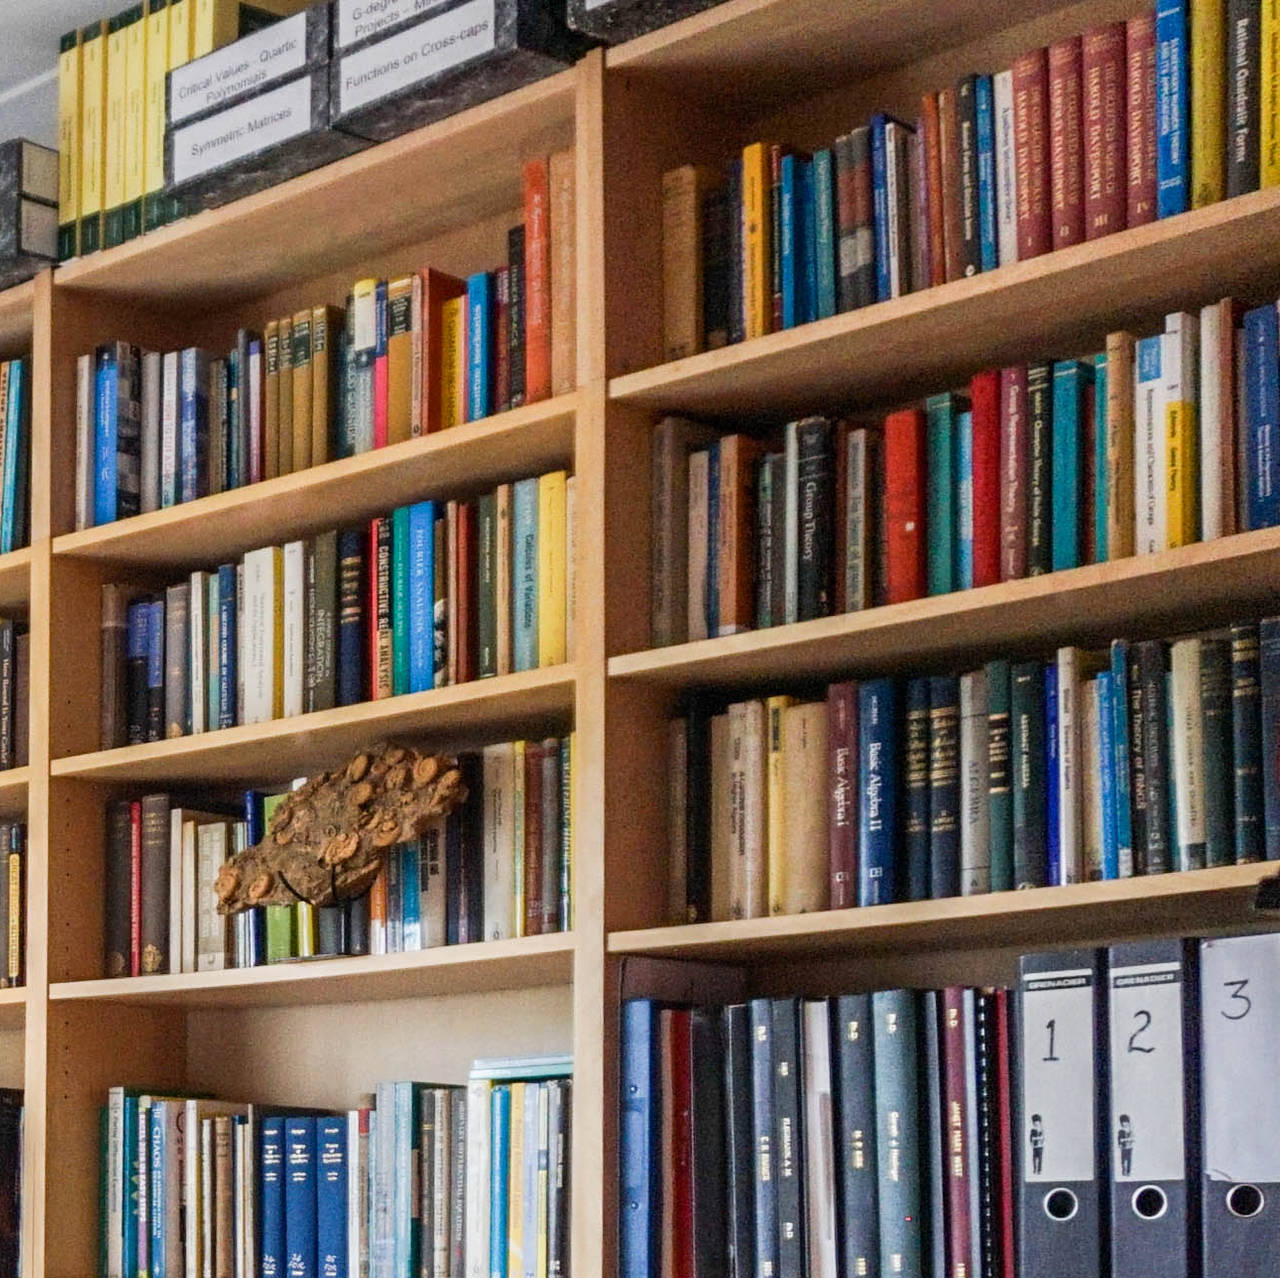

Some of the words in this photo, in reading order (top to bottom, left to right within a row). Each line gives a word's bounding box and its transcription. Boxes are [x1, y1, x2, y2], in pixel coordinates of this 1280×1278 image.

[355, 12, 400, 37] Projects
[1235, 18, 1249, 67] Rational
[178, 76, 213, 100] Critical
[216, 62, 250, 83] Values
[259, 39, 297, 63] Quartic
[345, 58, 400, 90] Functions
[403, 51, 417, 65] on
[421, 21, 489, 57] Cross-caps
[205, 70, 268, 104] Polynomials
[1088, 66, 1101, 121] HAROLD
[1130, 51, 1142, 105] HAROLD
[1235, 69, 1249, 126] Quadratic
[1017, 90, 1029, 143] HAROLD
[1053, 79, 1064, 131] HAROLD
[191, 128, 245, 158] Symmetric
[248, 108, 292, 134] Matrices
[1130, 109, 1142, 186] DAVENPORT
[1235, 128, 1249, 163] Forms
[1053, 135, 1064, 211] DAVENPORT
[1088, 125, 1101, 201] DAVENPORT
[1017, 147, 1029, 221] DAVENPORT
[1007, 385, 1019, 413] Group
[801, 482, 817, 520] Group
[1007, 482, 1019, 512] Theory
[524, 533, 536, 571] Calculus
[801, 522, 817, 561] Theory
[377, 546, 390, 615] CONSTRUCTIVE
[524, 585, 536, 629] Variations
[315, 609, 326, 684] INTEGRATION
[377, 617, 390, 643] REAL
[1, 658, 10, 677] How
[377, 645, 390, 690] ANALYSIS
[1, 679, 10, 706] Round
[1132, 689, 1143, 710] The
[1, 717, 10, 737] Your
[1132, 713, 1147, 753] Theory
[836, 747, 849, 774] Basic
[870, 742, 881, 770] Basic
[1135, 756, 1144, 770] of
[834, 775, 851, 820] Algebra
[867, 772, 881, 816] Algebra
[1135, 772, 1147, 810] RINGS
[870, 817, 881, 831] II
[1028, 977, 1087, 991] GRENADIER
[1115, 973, 1175, 987] GRENADIER
[1220, 979, 1252, 1020] 3
[1042, 1018, 1061, 1063] 1
[1127, 1009, 1157, 1055] 2
[152, 1126, 162, 1168] CHAOS
[139, 1174, 147, 1197] EASY
